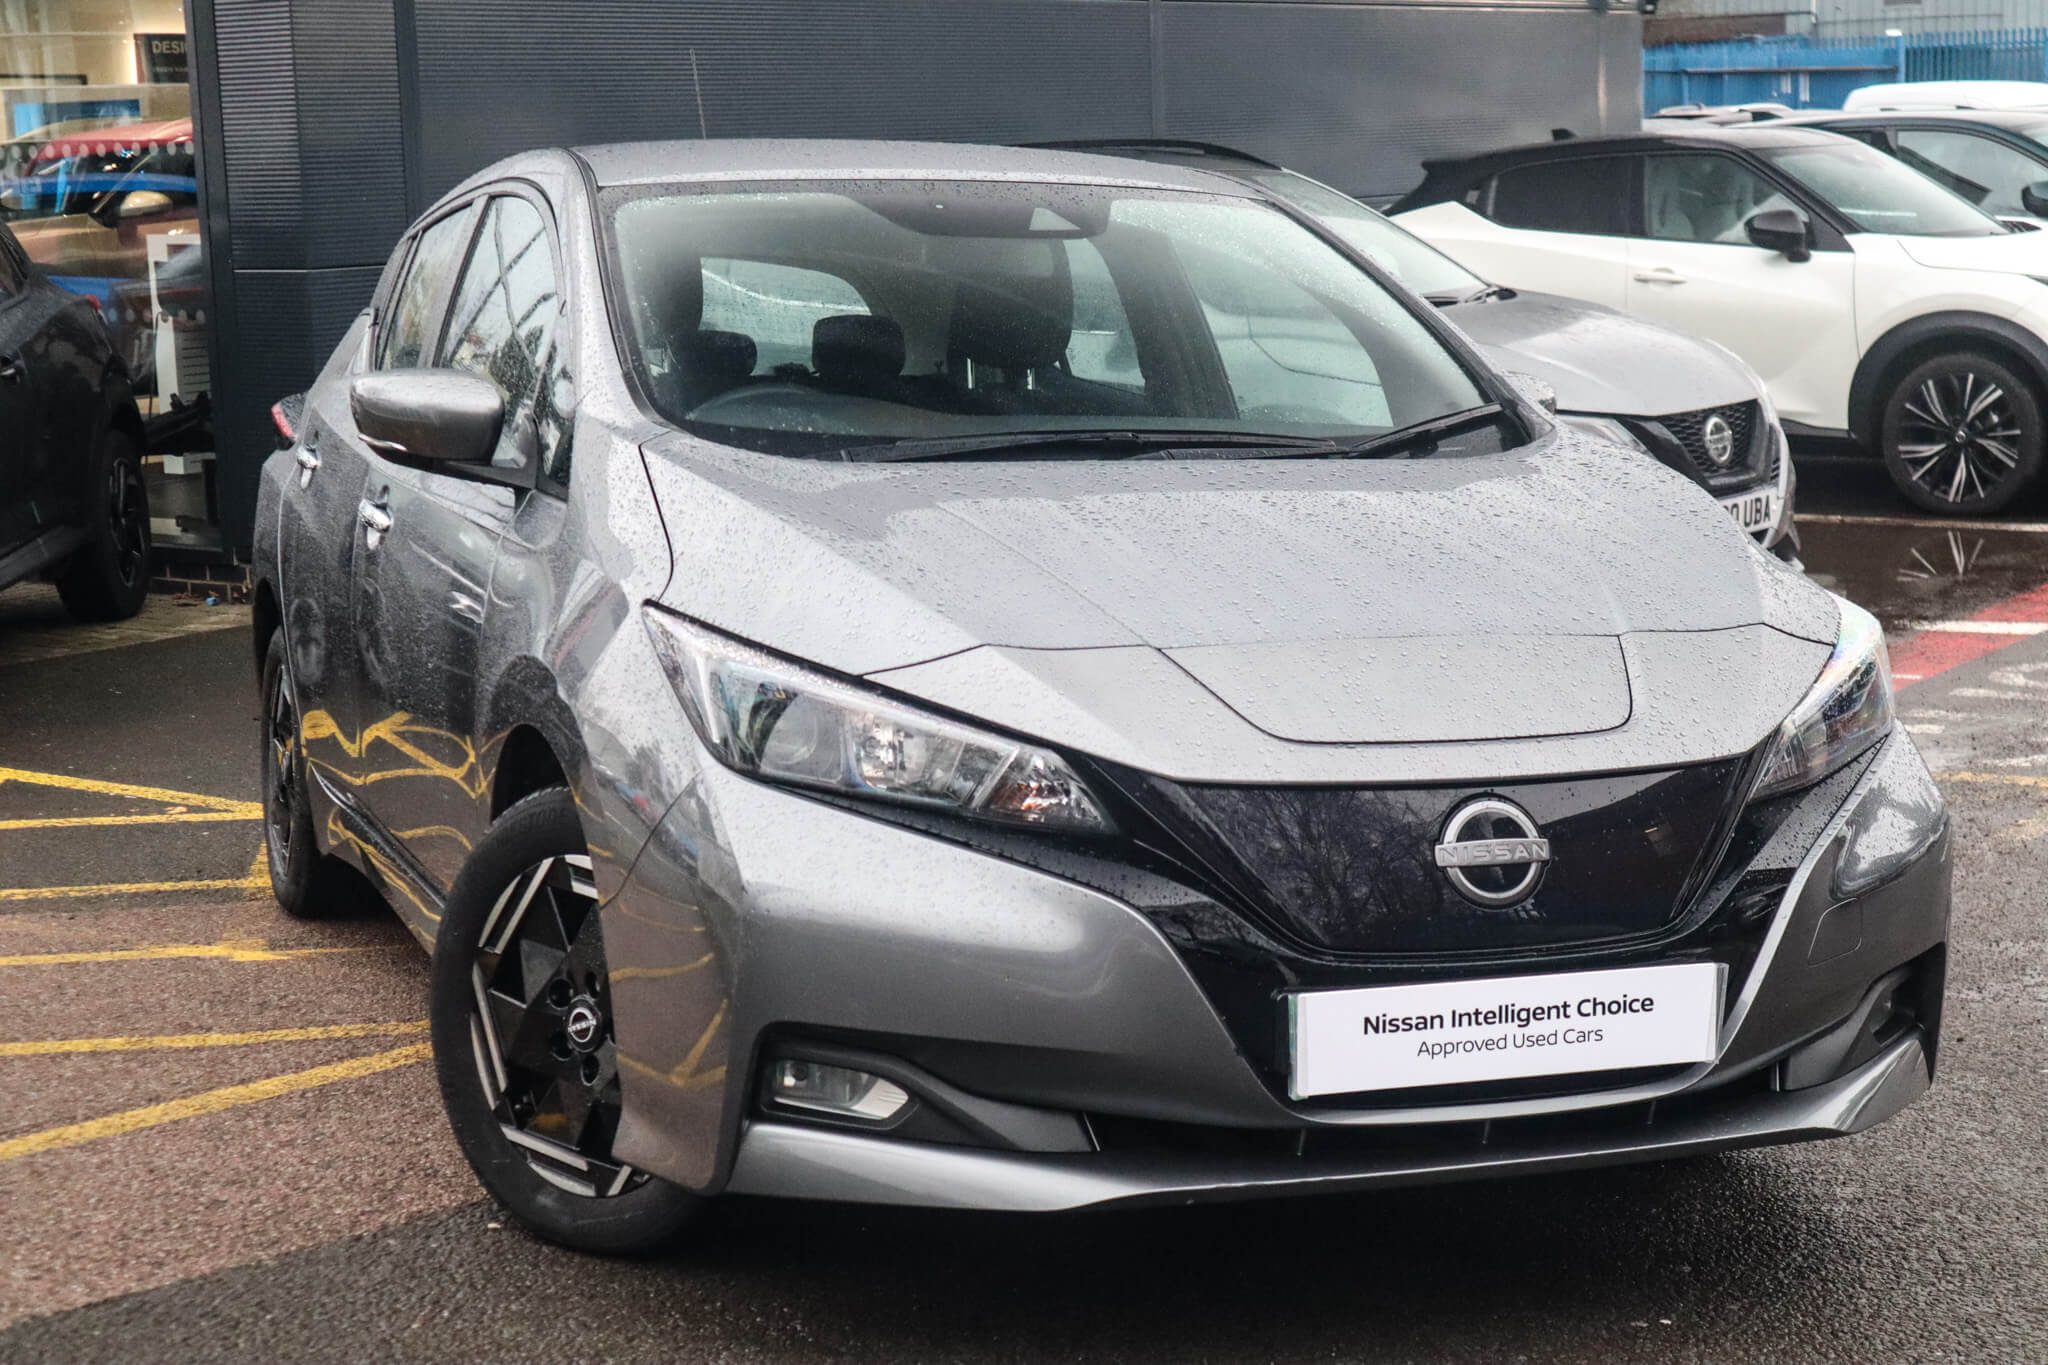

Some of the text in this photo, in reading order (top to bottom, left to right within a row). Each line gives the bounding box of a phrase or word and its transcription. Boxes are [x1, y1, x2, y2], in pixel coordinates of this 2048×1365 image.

[152, 40, 186, 54] DESI
[1743, 495, 1771, 528] UBA
[1440, 843, 1547, 863] NISSAN
[1363, 994, 1654, 1035] Nissan Intelligent Choice
[1417, 1028, 1603, 1059] Approved Used Cars
